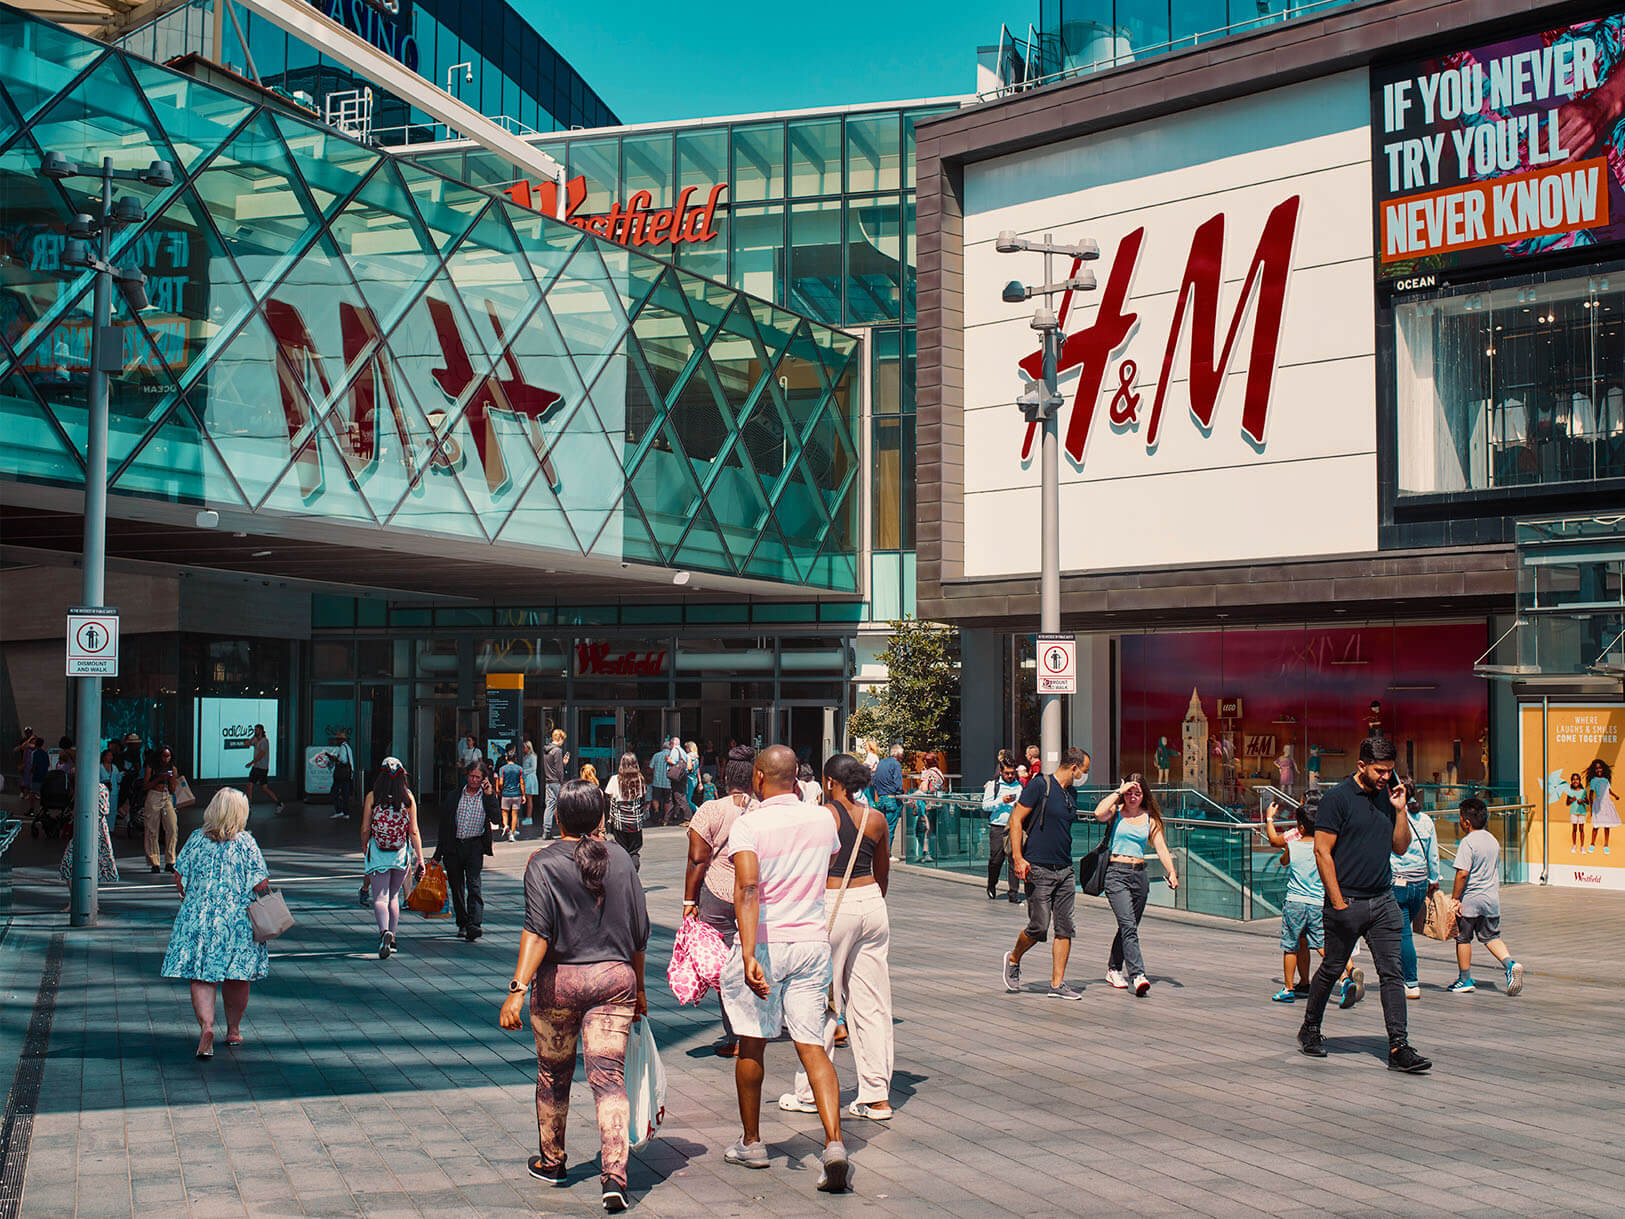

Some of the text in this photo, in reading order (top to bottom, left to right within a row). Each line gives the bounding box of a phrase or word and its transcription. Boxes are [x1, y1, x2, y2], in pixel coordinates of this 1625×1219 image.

[326, 0, 420, 73] ASINO
[1384, 38, 1598, 133] IF YOU NEVER
[1384, 109, 1570, 193] TRY YOU'LL
[1386, 167, 1599, 255] NEVER KNOW
[1397, 276, 1435, 291] OCEAN
[1018, 194, 1301, 465] H&M
[574, 642, 667, 675] Westfield
[1223, 704, 1236, 712] LEGO
[1575, 715, 1599, 724] WHERE
[1556, 725, 1583, 734] LAUGHS
[1592, 725, 1617, 734] SMILES
[1556, 734, 1617, 744] COME TOGETHER
